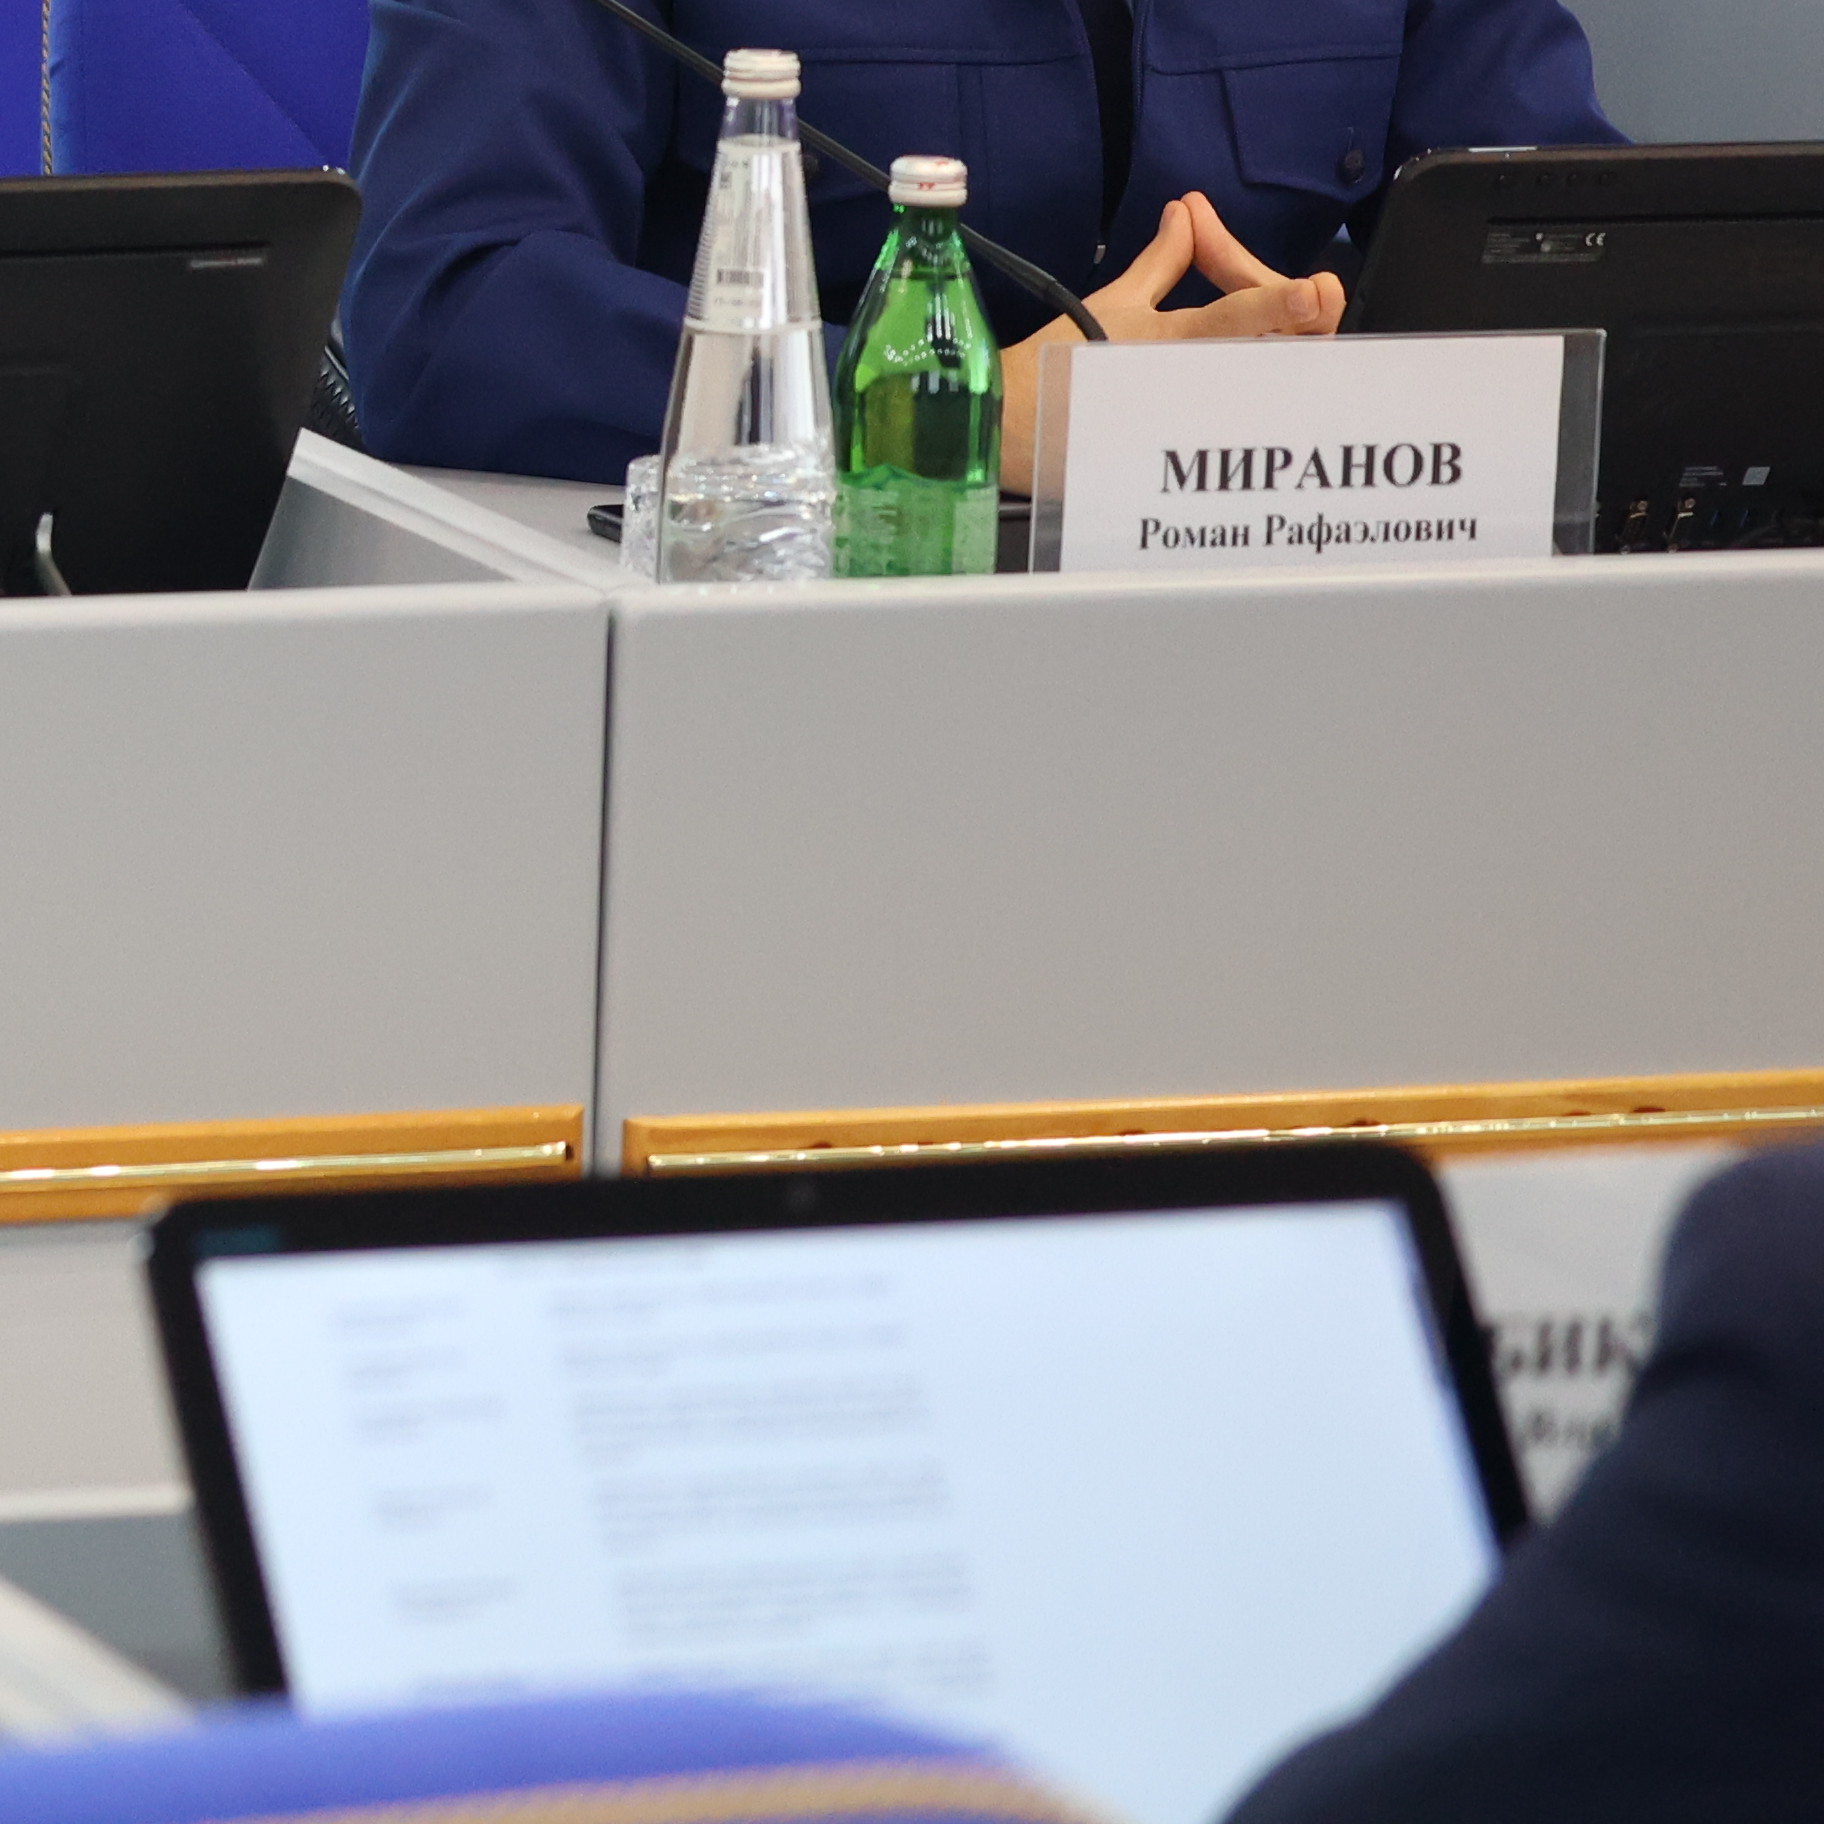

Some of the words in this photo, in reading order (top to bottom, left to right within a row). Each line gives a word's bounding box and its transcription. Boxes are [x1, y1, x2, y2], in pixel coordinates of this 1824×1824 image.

[1161, 442, 1464, 494] МИРАНОВ
[1139, 518, 1251, 551] Роман
[1264, 513, 1478, 555] Рафаэлович
